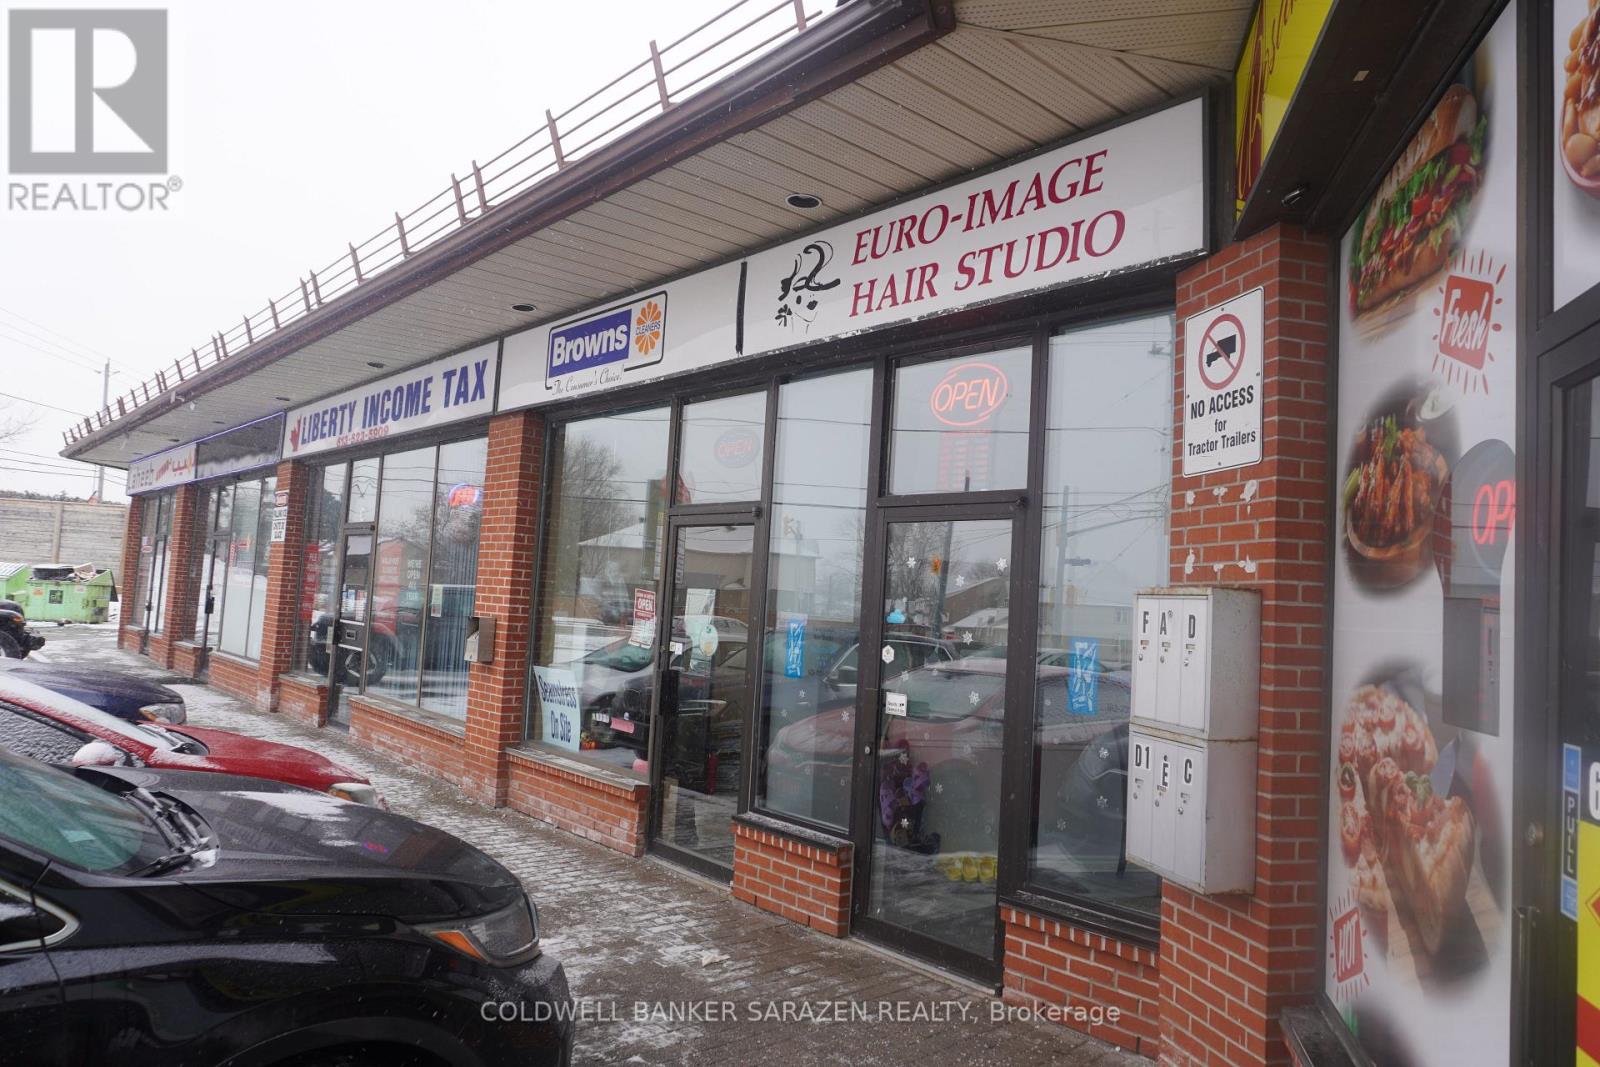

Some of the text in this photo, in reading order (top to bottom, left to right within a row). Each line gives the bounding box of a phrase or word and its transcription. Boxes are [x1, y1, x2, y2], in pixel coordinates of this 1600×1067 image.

[851, 150, 1109, 266] EURO-IMAGE
[848, 209, 1127, 318] HAIR STUDIO
[1440, 287, 1490, 351] Fresh
[553, 321, 661, 368] Browns CLEANERS
[301, 359, 488, 445] LIBERTY INCOME TAX
[933, 378, 1000, 412] OPEN
[1190, 385, 1254, 419] NO ACCESS
[1214, 418, 1227, 433] for
[1188, 430, 1256, 456] Tractor Trailers
[1188, 614, 1196, 639] D
[538, 674, 577, 709] Seamstress
[550, 709, 571, 743] On Site
[1184, 758, 1192, 784] C
